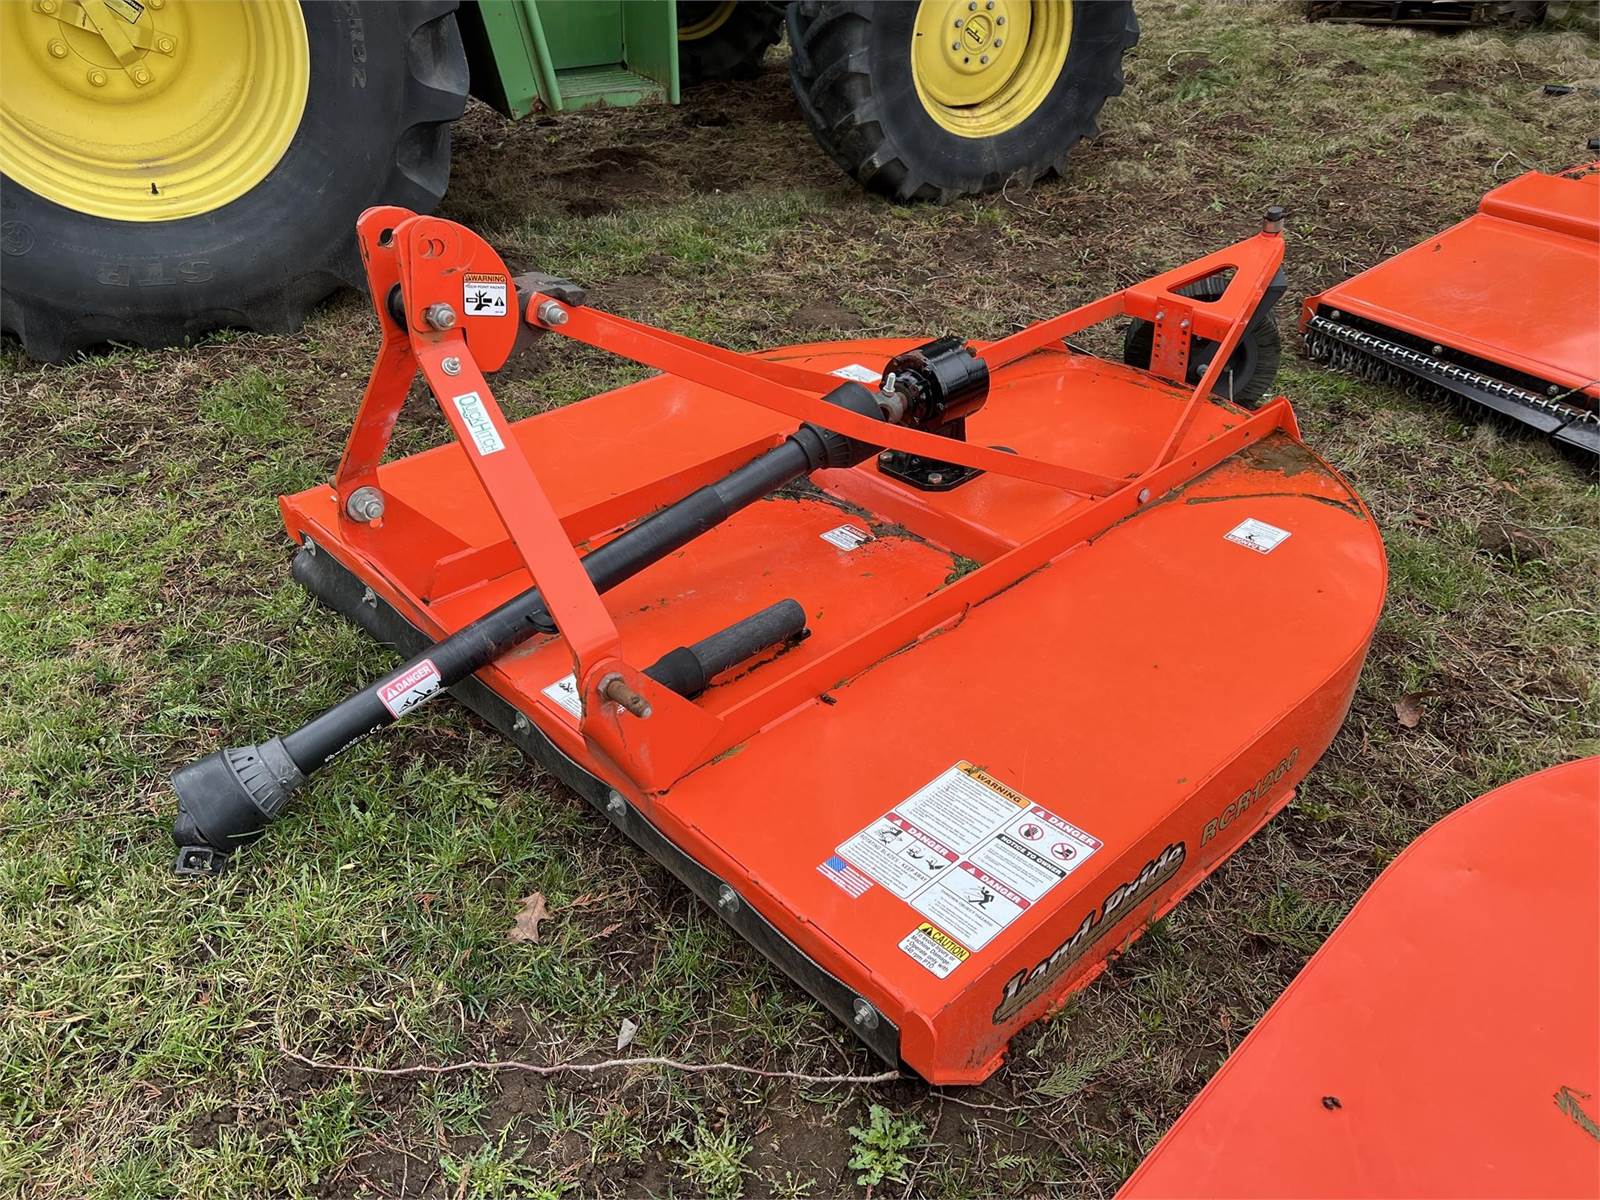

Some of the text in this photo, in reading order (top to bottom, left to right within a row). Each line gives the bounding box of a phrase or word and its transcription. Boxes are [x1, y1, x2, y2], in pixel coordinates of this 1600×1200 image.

[395, 666, 431, 691] DANGER
[977, 773, 1022, 803] WARNING
[1201, 747, 1299, 849] RCR1260
[907, 826, 949, 855] DANGER
[1048, 816, 1096, 845] DANGER
[1001, 835, 1027, 854] NOTICE
[1026, 850, 1037, 859] TO
[1036, 857, 1062, 876] OWNER
[980, 874, 1021, 904] DANGER
[1001, 910, 1097, 1005] Land
[1101, 841, 1187, 917] Pride
[909, 941, 928, 956] Operate
[911, 934, 931, 950] Machine
[922, 936, 936, 948] avoid
[932, 931, 967, 959] CAUTION
[922, 958, 935, 969] PTO
